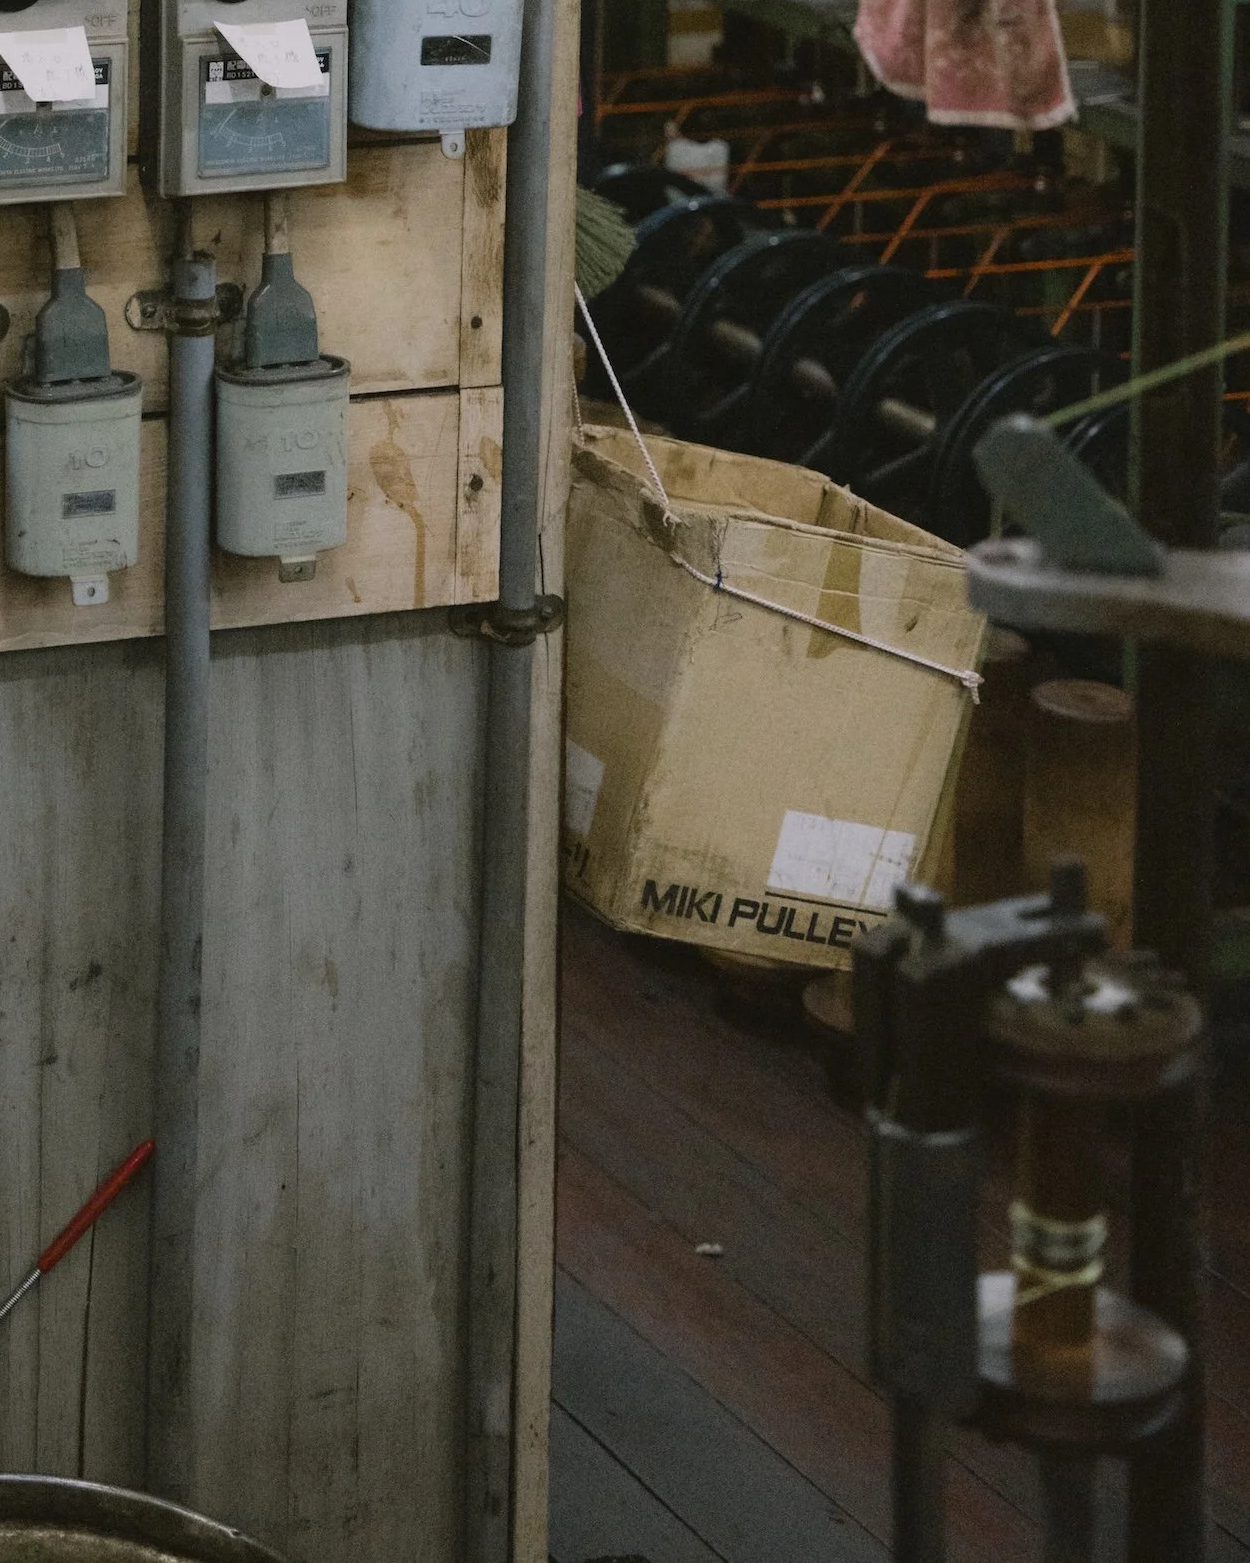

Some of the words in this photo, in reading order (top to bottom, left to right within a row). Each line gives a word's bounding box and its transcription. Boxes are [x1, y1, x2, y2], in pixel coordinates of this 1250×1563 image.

[91, 14, 117, 27] OFF
[311, 5, 337, 17] OFF
[280, 430, 321, 453] 10
[68, 447, 111, 471] 10
[640, 878, 723, 925] MIKI
